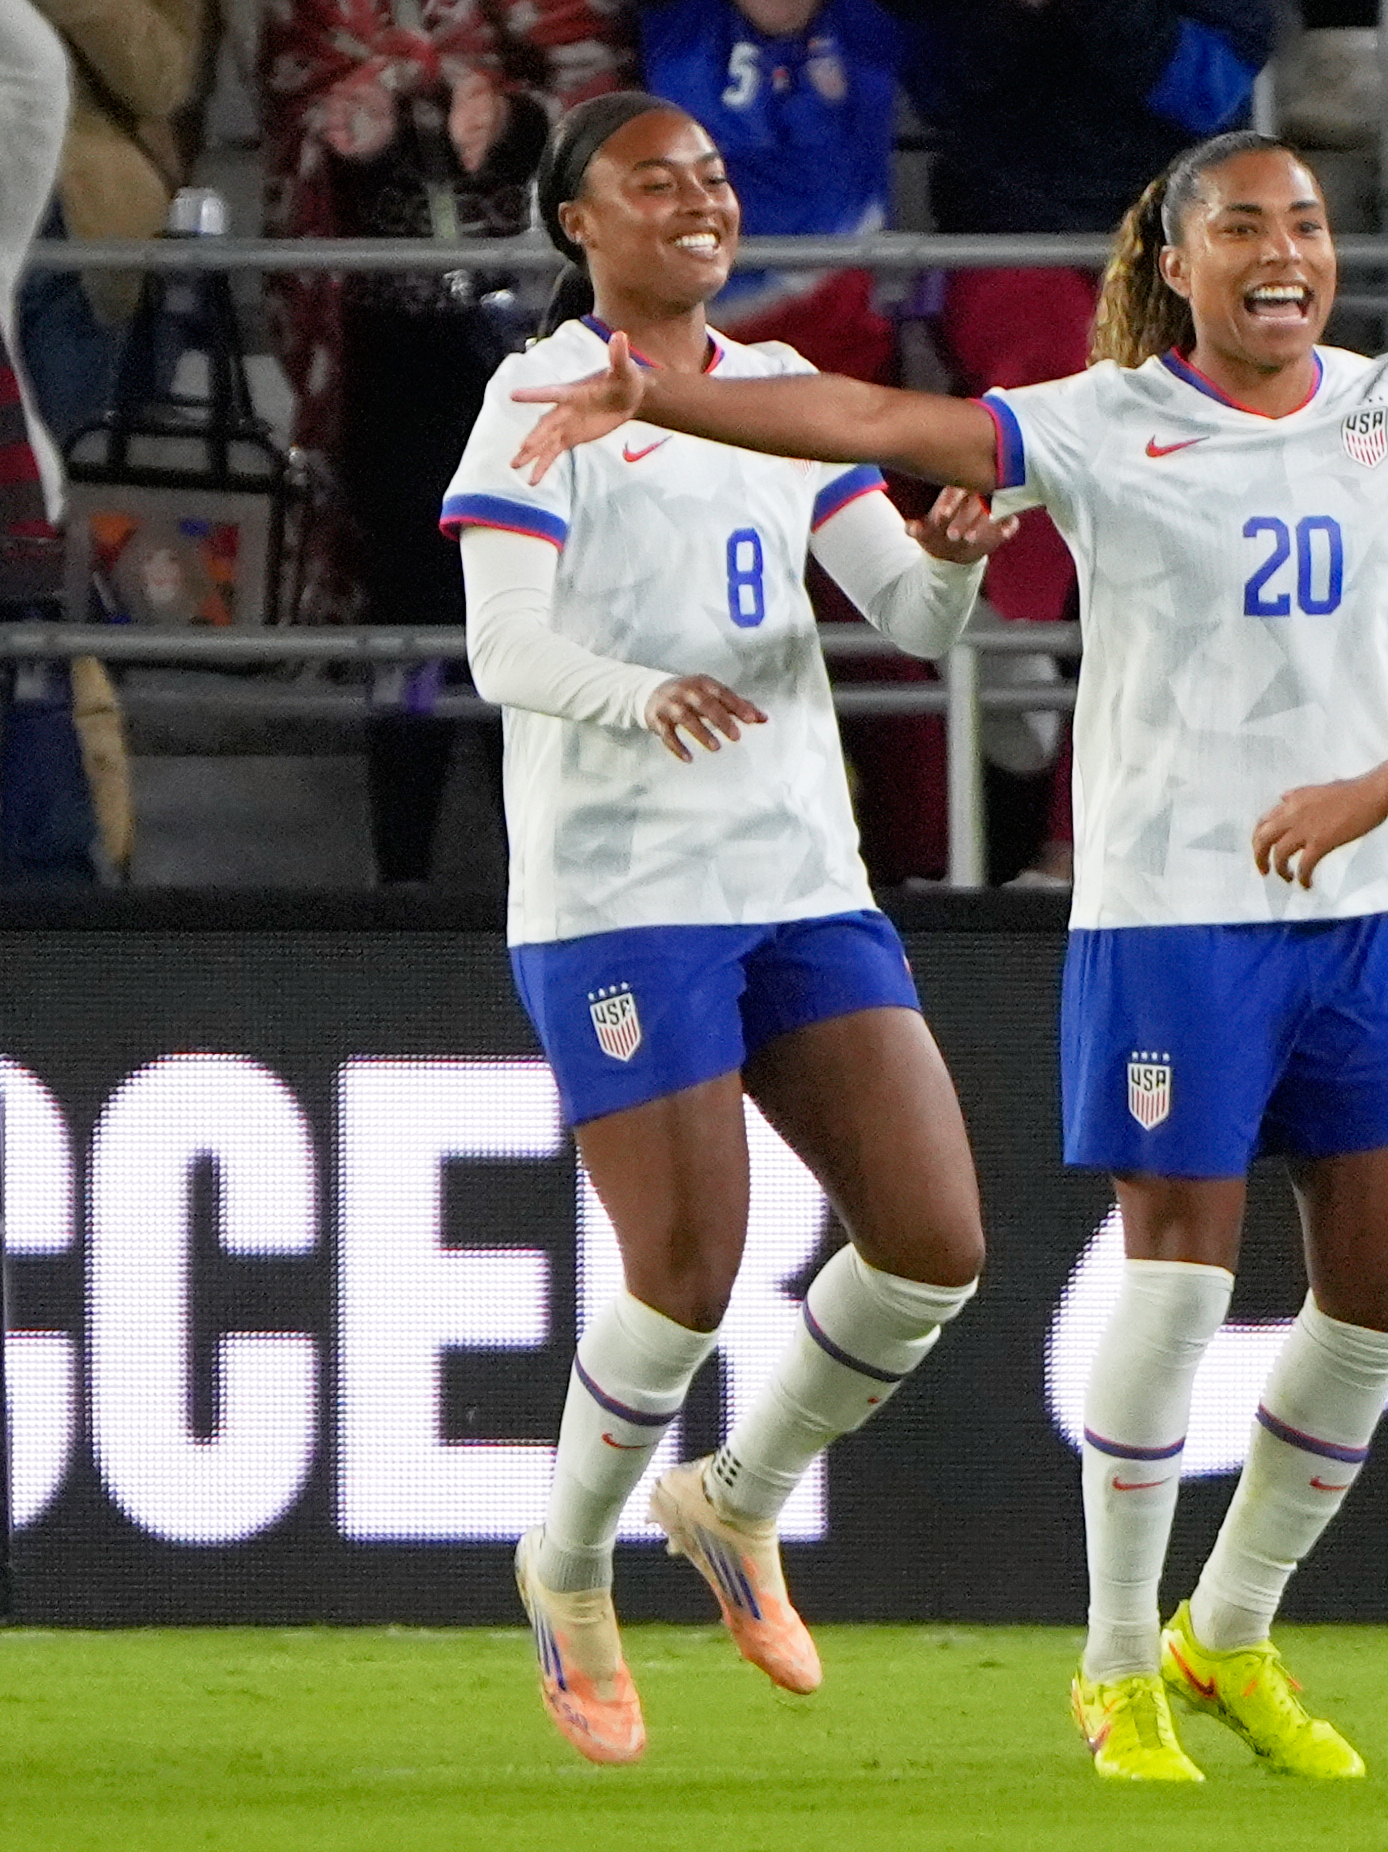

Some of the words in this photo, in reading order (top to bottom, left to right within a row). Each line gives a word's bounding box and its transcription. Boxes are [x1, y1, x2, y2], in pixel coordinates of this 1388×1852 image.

[1345, 410, 1384, 435] USA
[726, 527, 765, 628] 8
[1242, 515, 1343, 616] 20
[1131, 1065, 1167, 1092] USA
